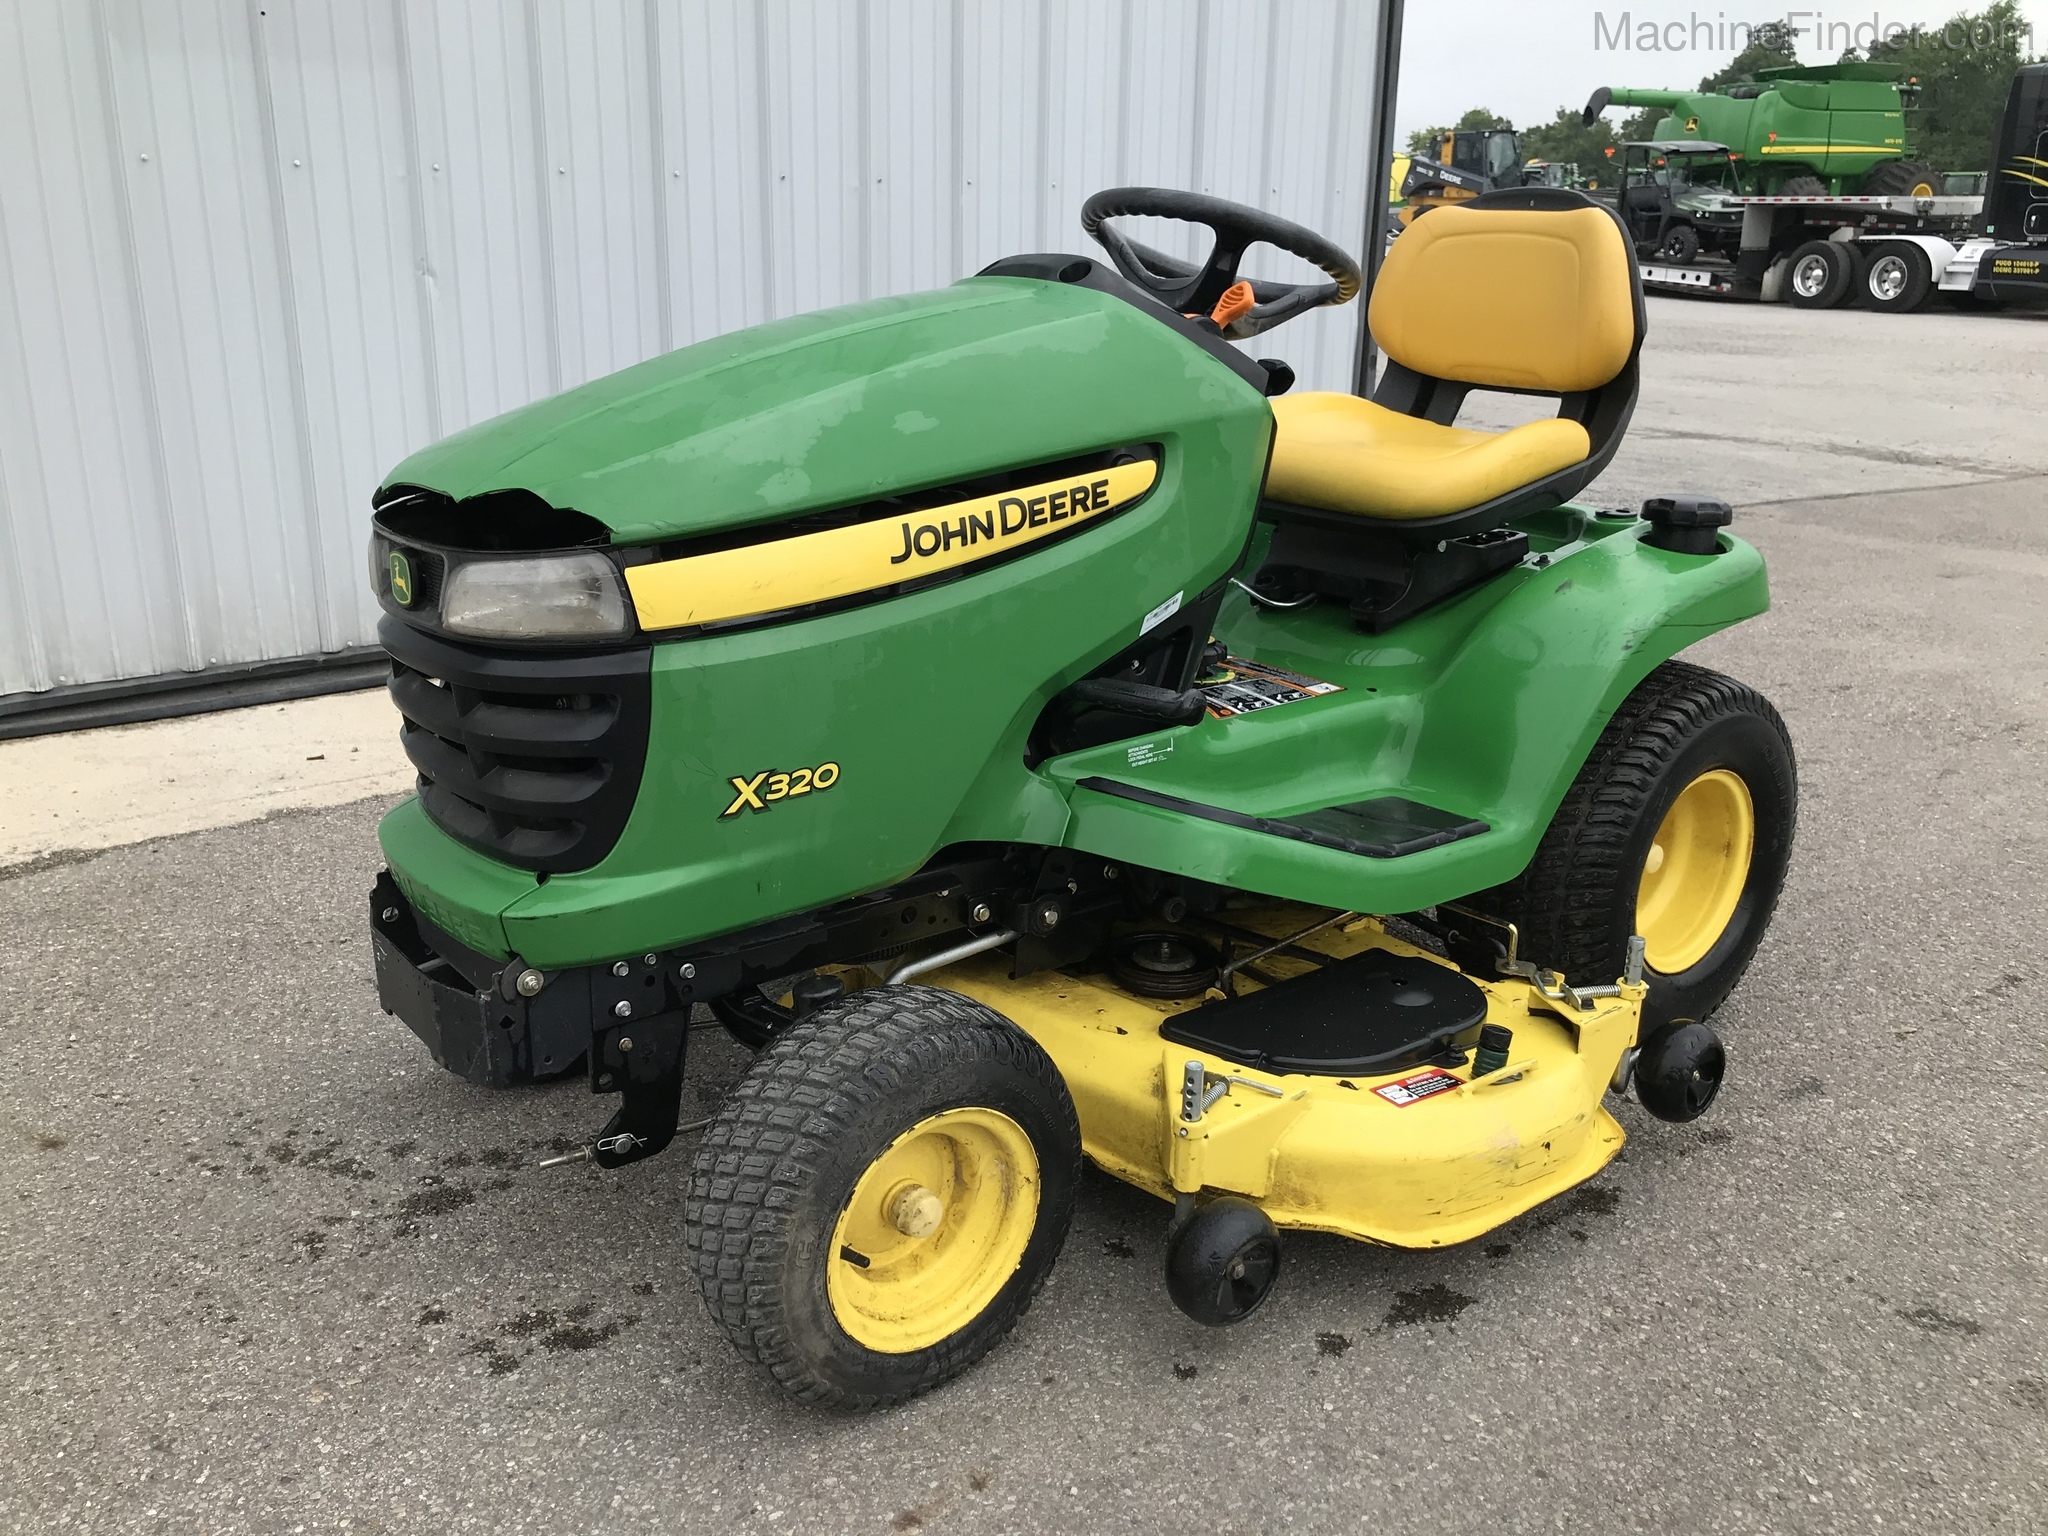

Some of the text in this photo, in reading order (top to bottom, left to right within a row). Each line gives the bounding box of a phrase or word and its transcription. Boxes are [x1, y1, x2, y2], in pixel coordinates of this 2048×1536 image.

[890, 478, 1110, 565] JOHN DEERE
[717, 761, 840, 820] X320
